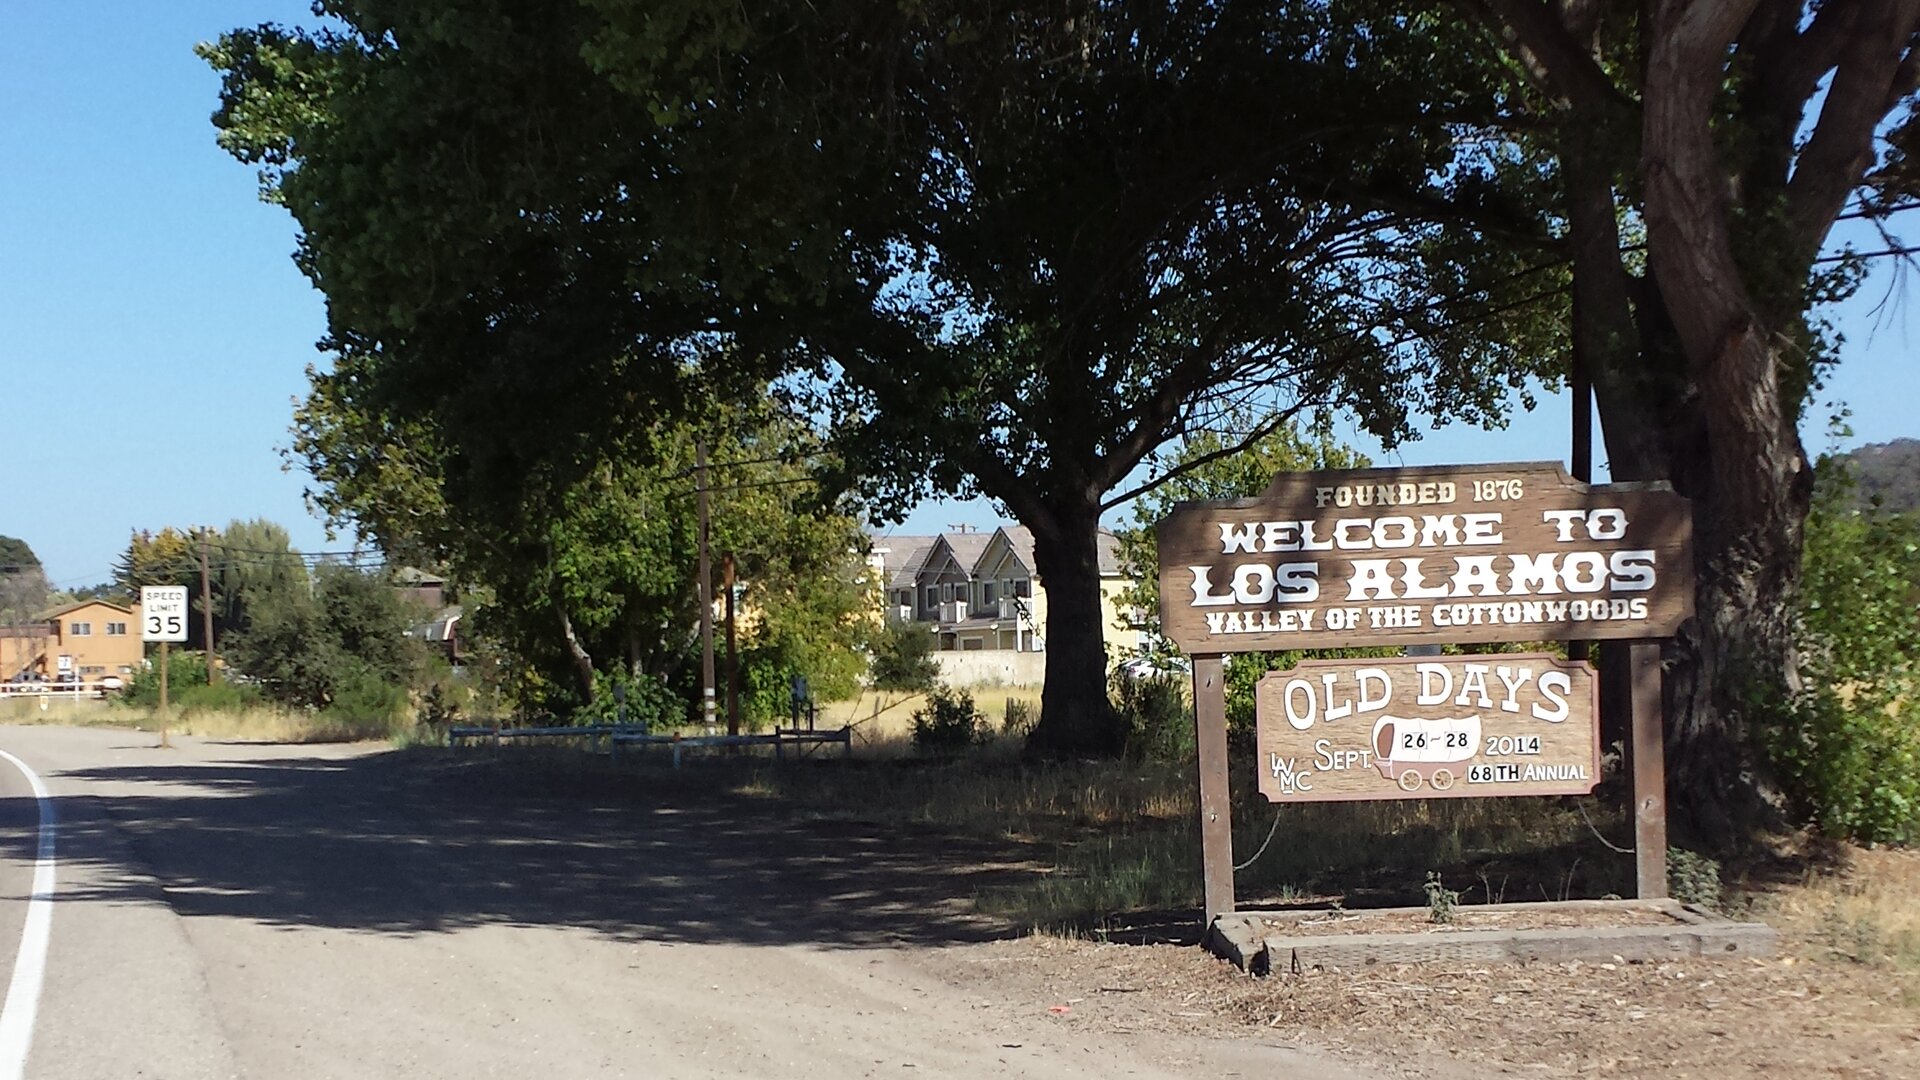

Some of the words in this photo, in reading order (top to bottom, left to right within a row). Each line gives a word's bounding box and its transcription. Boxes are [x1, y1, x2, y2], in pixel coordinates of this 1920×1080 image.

[1316, 481, 1456, 508] FOUNDED
[1472, 479, 1524, 501] 1876
[1219, 513, 1503, 554] WELCOME
[1543, 507, 1629, 542] TO
[1188, 562, 1320, 606] LOS
[1344, 550, 1657, 601] ALAMOS
[146, 592, 182, 600] SPEED
[150, 604, 178, 612] LIMIT
[148, 616, 181, 634] 35
[1205, 611, 1315, 634] VALLEY
[1325, 607, 1364, 630] OF
[1367, 605, 1422, 628] THE
[1432, 598, 1648, 626] COTTONWOODS
[1284, 668, 1393, 730] OLD
[1416, 663, 1571, 723] DAYS
[1486, 737, 1540, 756] 2014
[1469, 765, 1520, 783] 68TH
